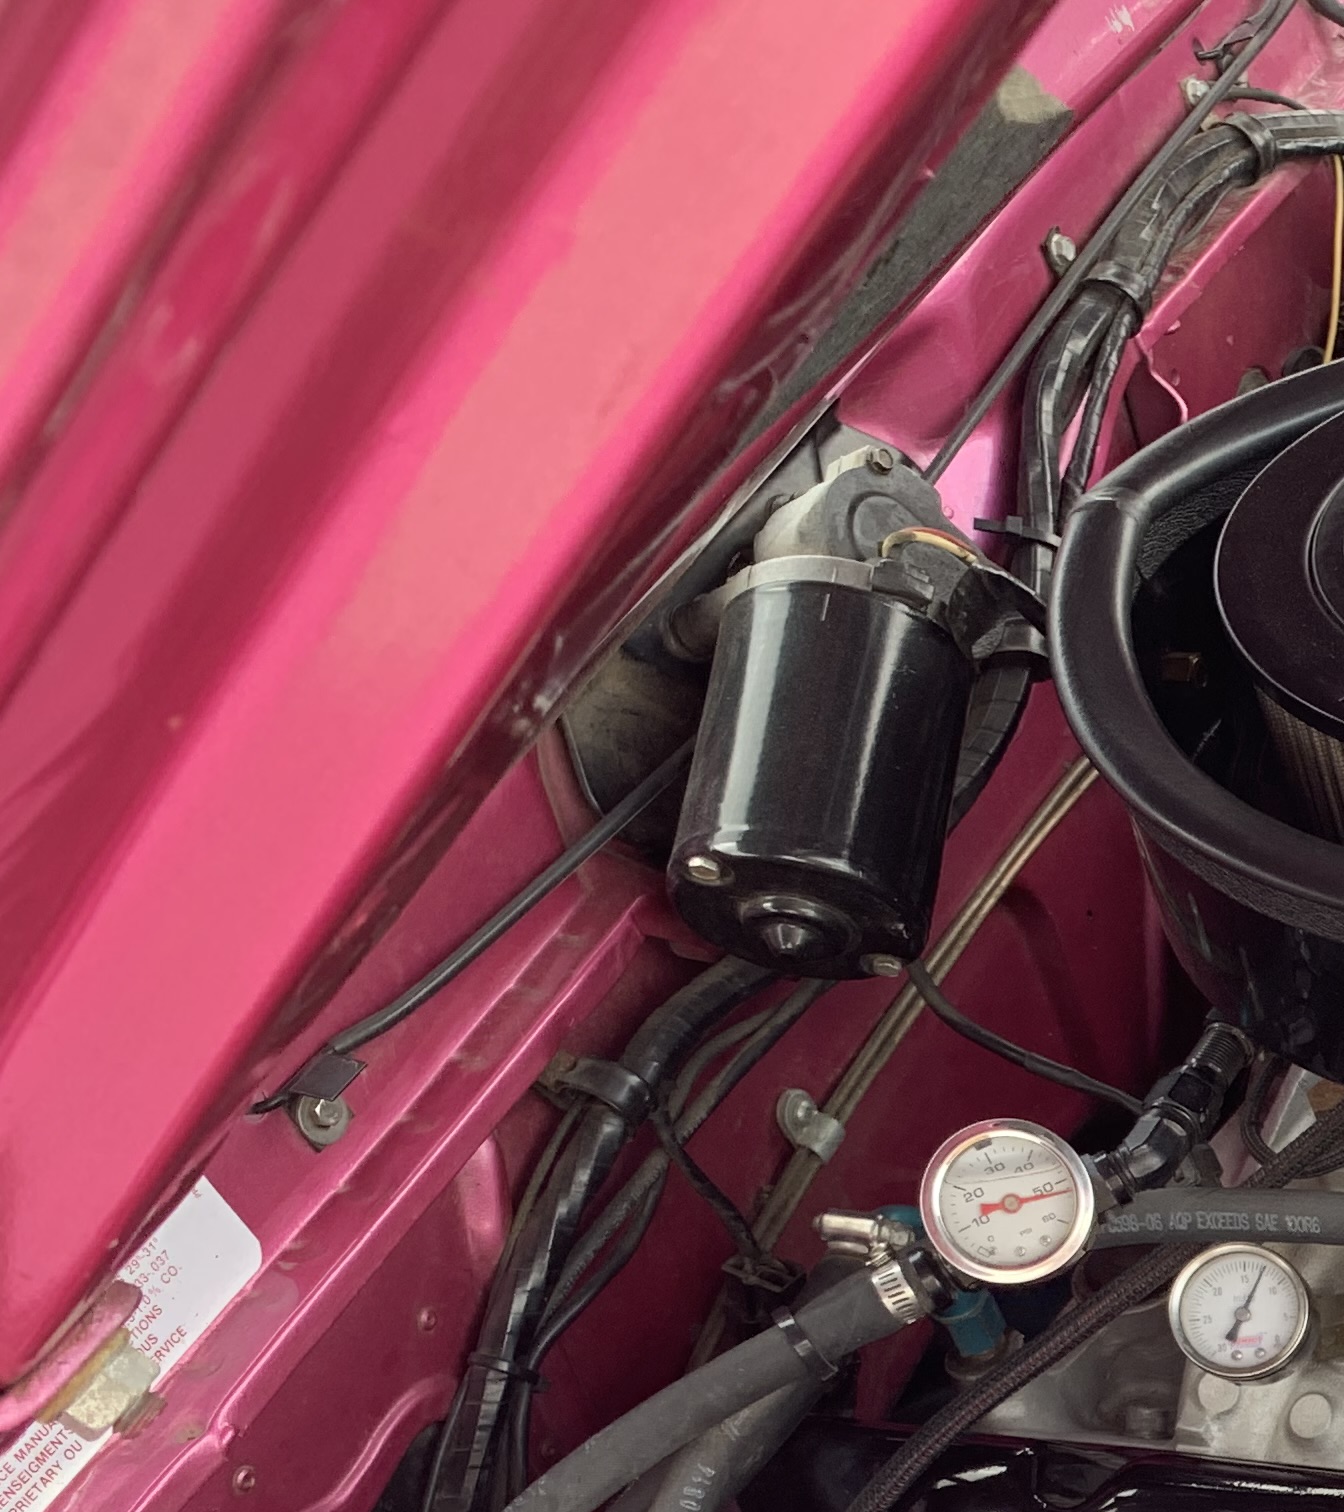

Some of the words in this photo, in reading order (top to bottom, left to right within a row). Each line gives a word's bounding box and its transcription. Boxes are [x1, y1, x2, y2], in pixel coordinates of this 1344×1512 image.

[983, 1161, 1006, 1175] 30
[1013, 1161, 1035, 1174] 40
[962, 1187, 985, 1203] 20
[1196, 1210, 1249, 1232] EXCEEDS
[1254, 1212, 1280, 1231] SAE
[13, 1420, 60, 1464] MANUA
[63, 1439, 83, 1461] OU
